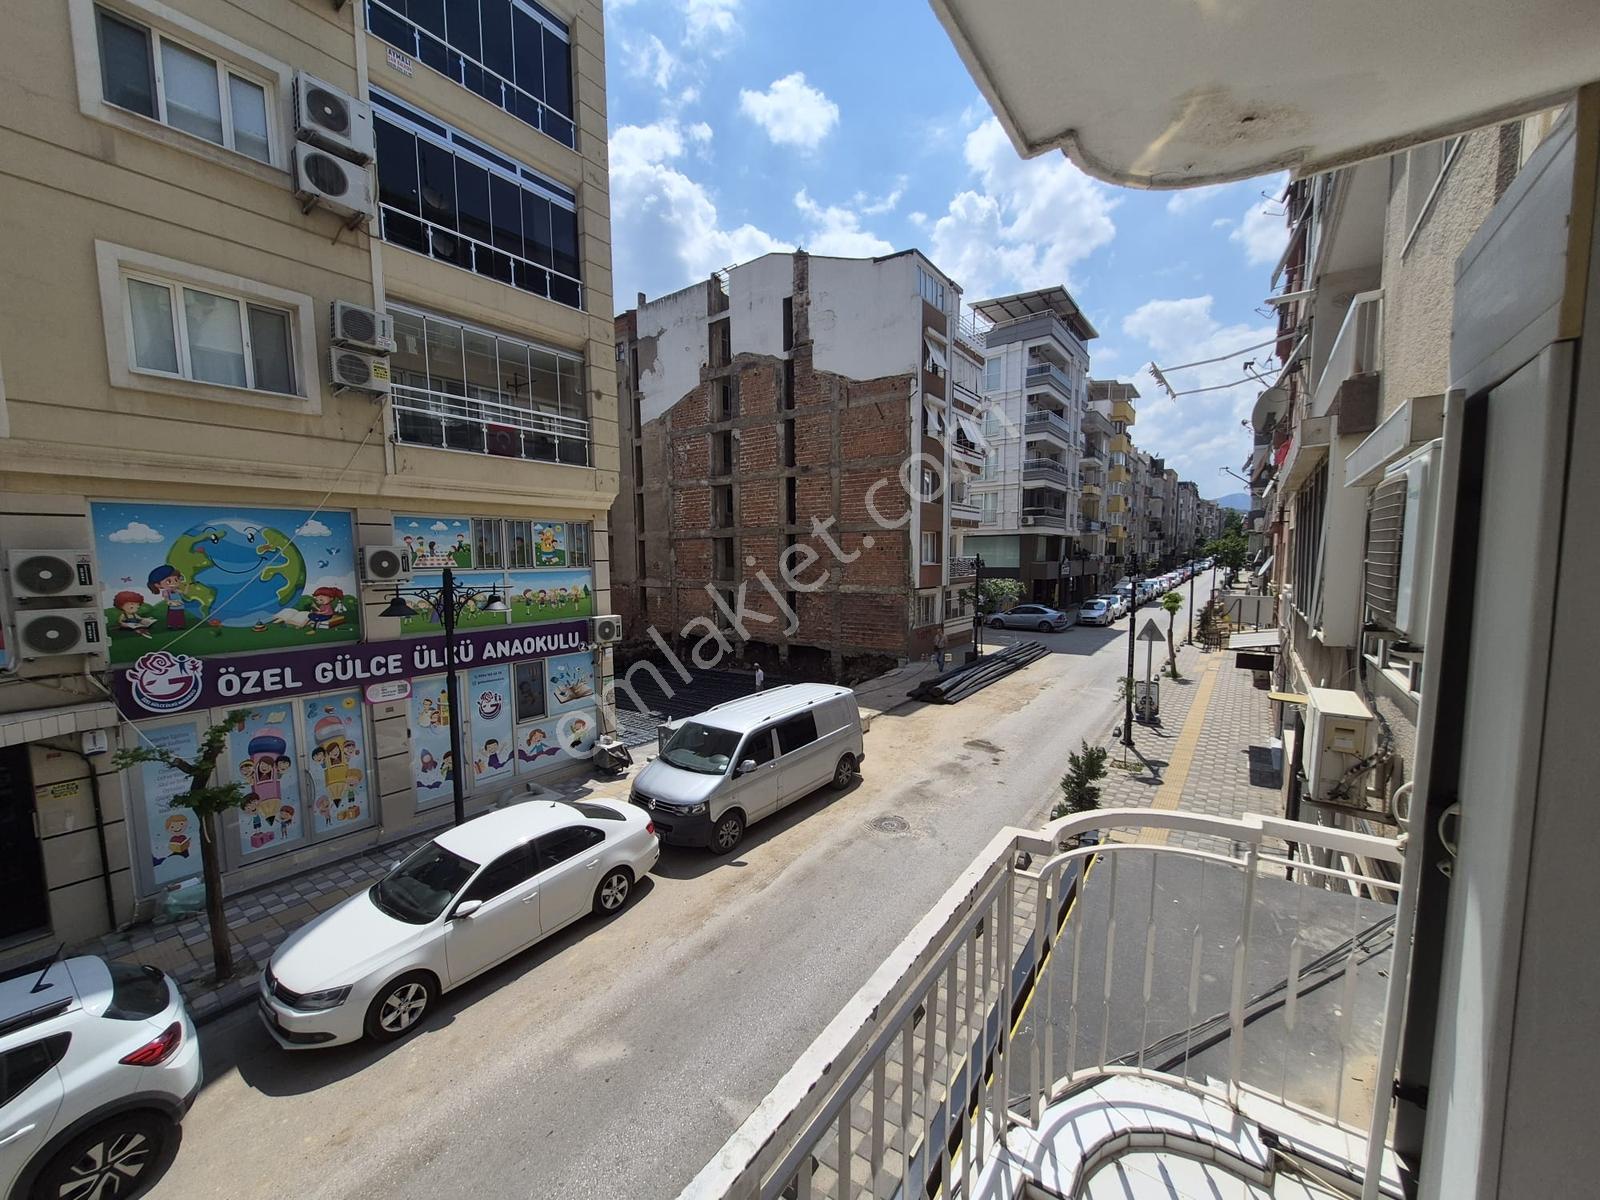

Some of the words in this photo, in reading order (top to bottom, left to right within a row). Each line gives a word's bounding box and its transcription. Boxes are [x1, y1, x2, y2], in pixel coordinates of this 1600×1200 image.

[217, 666, 303, 697] ÖZEL
[314, 654, 403, 684] GÜLCE
[414, 639, 474, 670] ÜLKÜ
[482, 631, 580, 660] ANAOKULU
